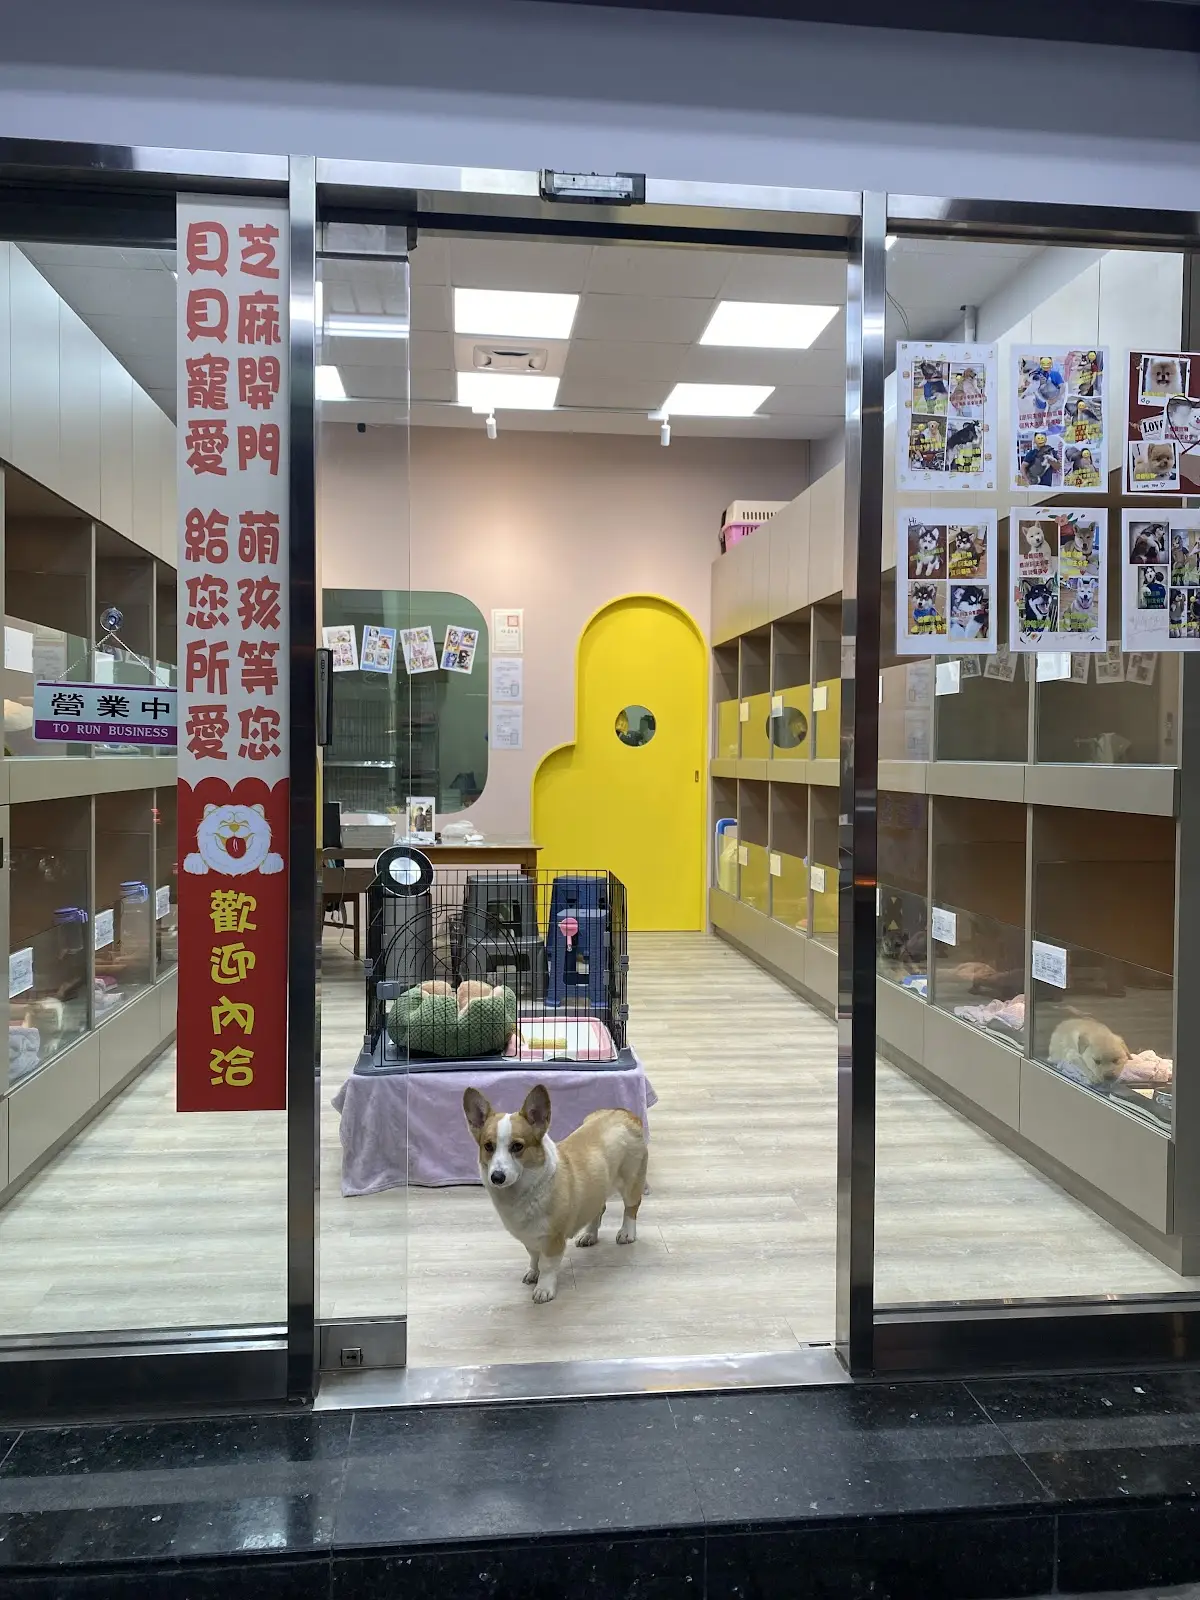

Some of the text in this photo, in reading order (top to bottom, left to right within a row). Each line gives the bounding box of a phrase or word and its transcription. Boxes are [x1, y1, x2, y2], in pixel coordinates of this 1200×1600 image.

[185, 221, 230, 761] 貝貝寵愛 給您所愛
[238, 224, 282, 761] 芝麻開門 萌孩等您
[51, 692, 170, 720] 營業中
[53, 723, 169, 738] TO RUN BUSINESS
